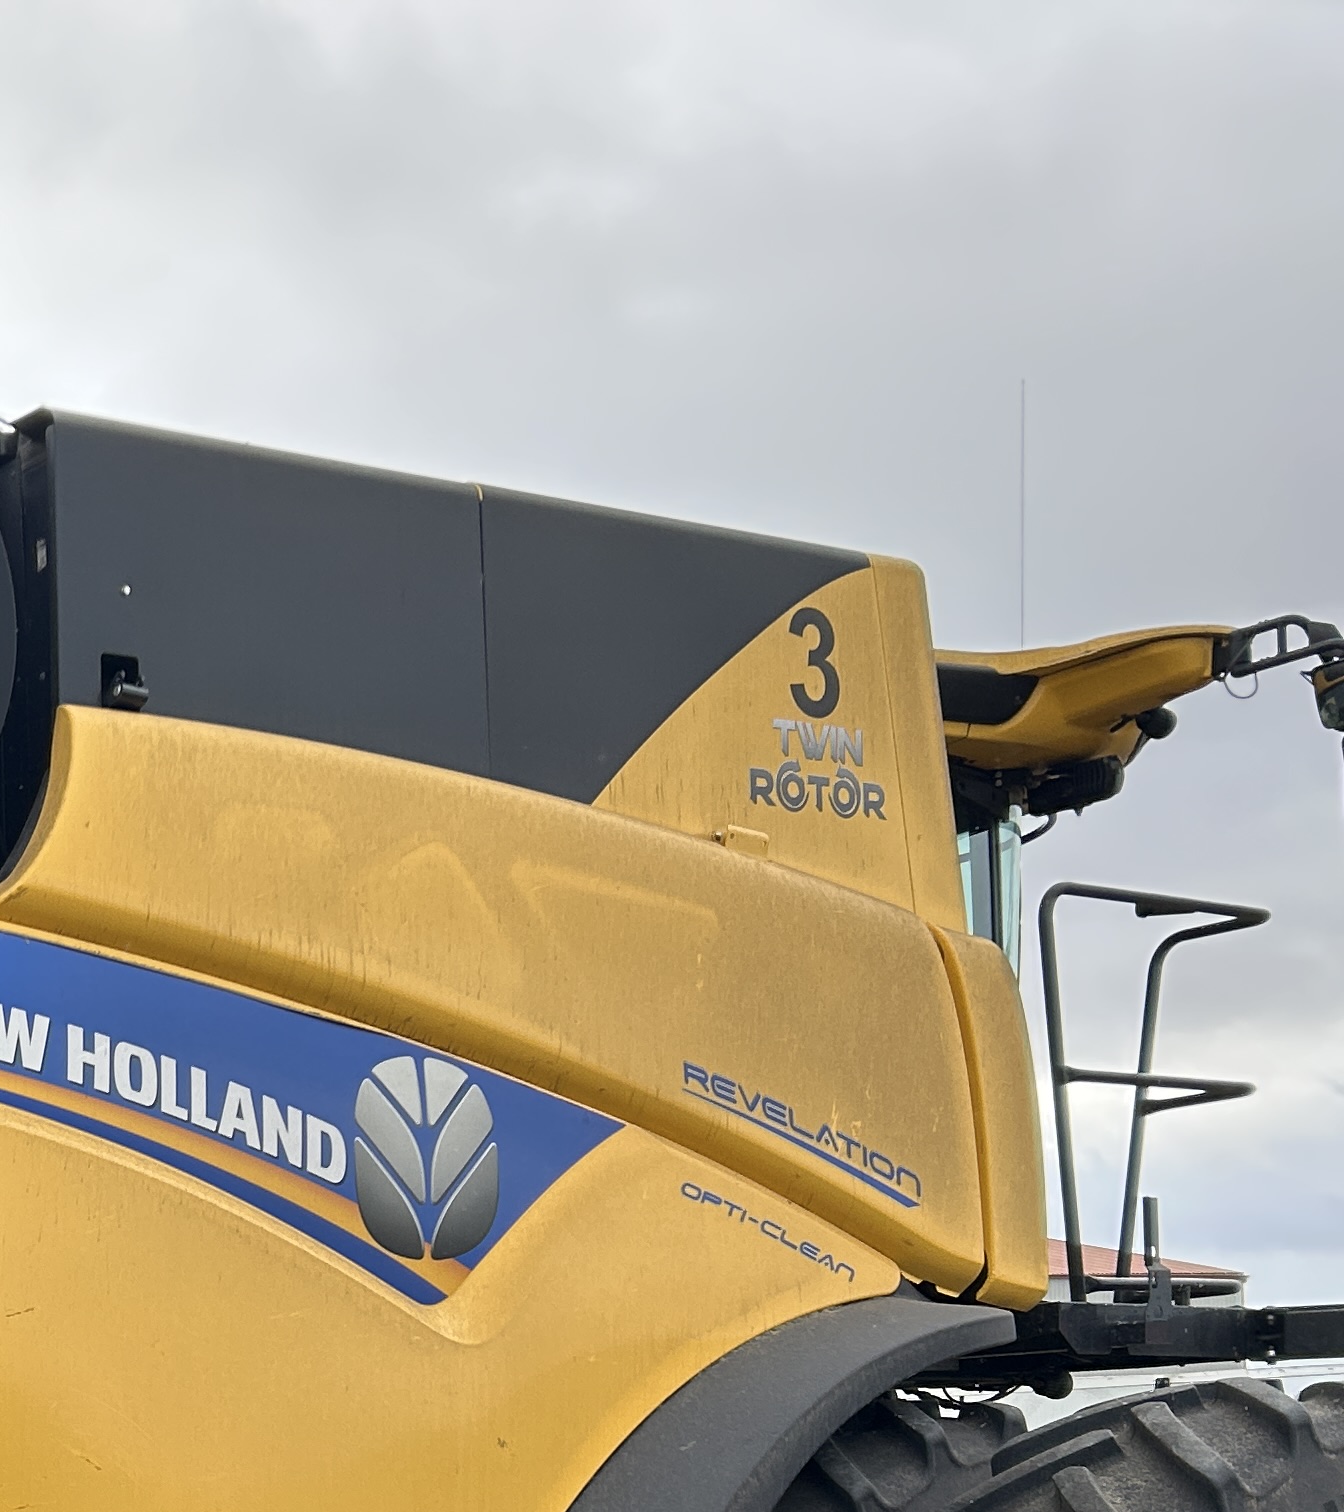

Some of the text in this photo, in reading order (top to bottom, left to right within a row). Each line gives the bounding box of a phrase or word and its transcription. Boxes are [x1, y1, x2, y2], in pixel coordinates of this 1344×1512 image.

[788, 606, 840, 718] 3
[749, 758, 888, 821] ROTOR
[772, 718, 863, 767] TWIN
[66, 1023, 348, 1184] HOLLAND
[682, 1060, 922, 1198] REVELATION
[681, 1182, 855, 1283] OPTI-CLEAN
